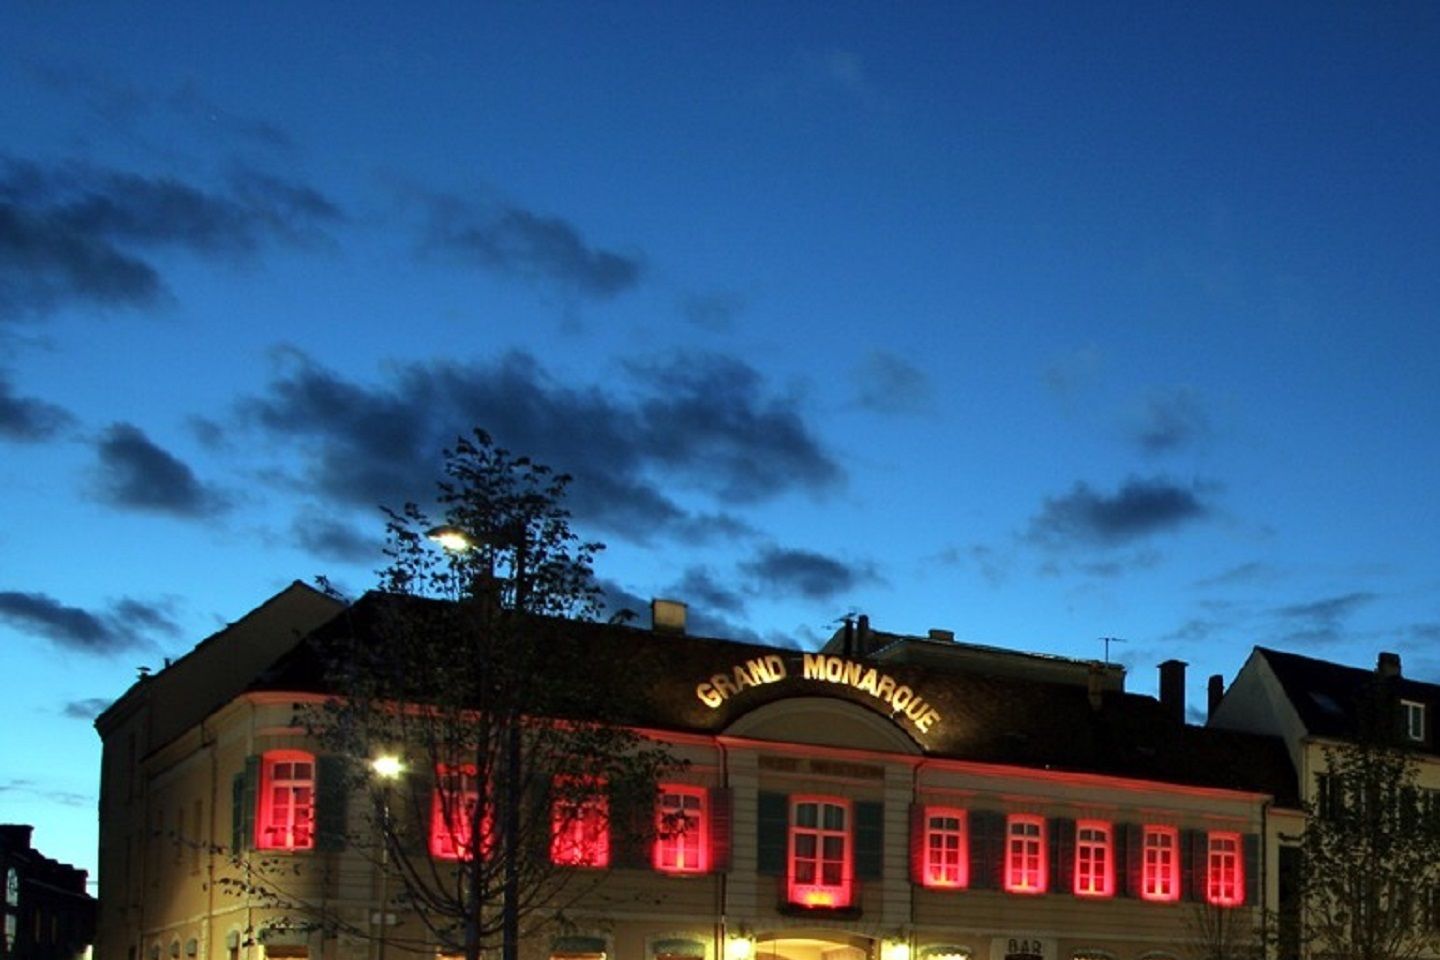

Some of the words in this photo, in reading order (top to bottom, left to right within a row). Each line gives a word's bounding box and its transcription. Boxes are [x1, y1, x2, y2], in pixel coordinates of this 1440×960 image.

[696, 654, 787, 709] GRAND
[802, 653, 941, 734] MONARQUE
[1008, 938, 1042, 954] BAR
